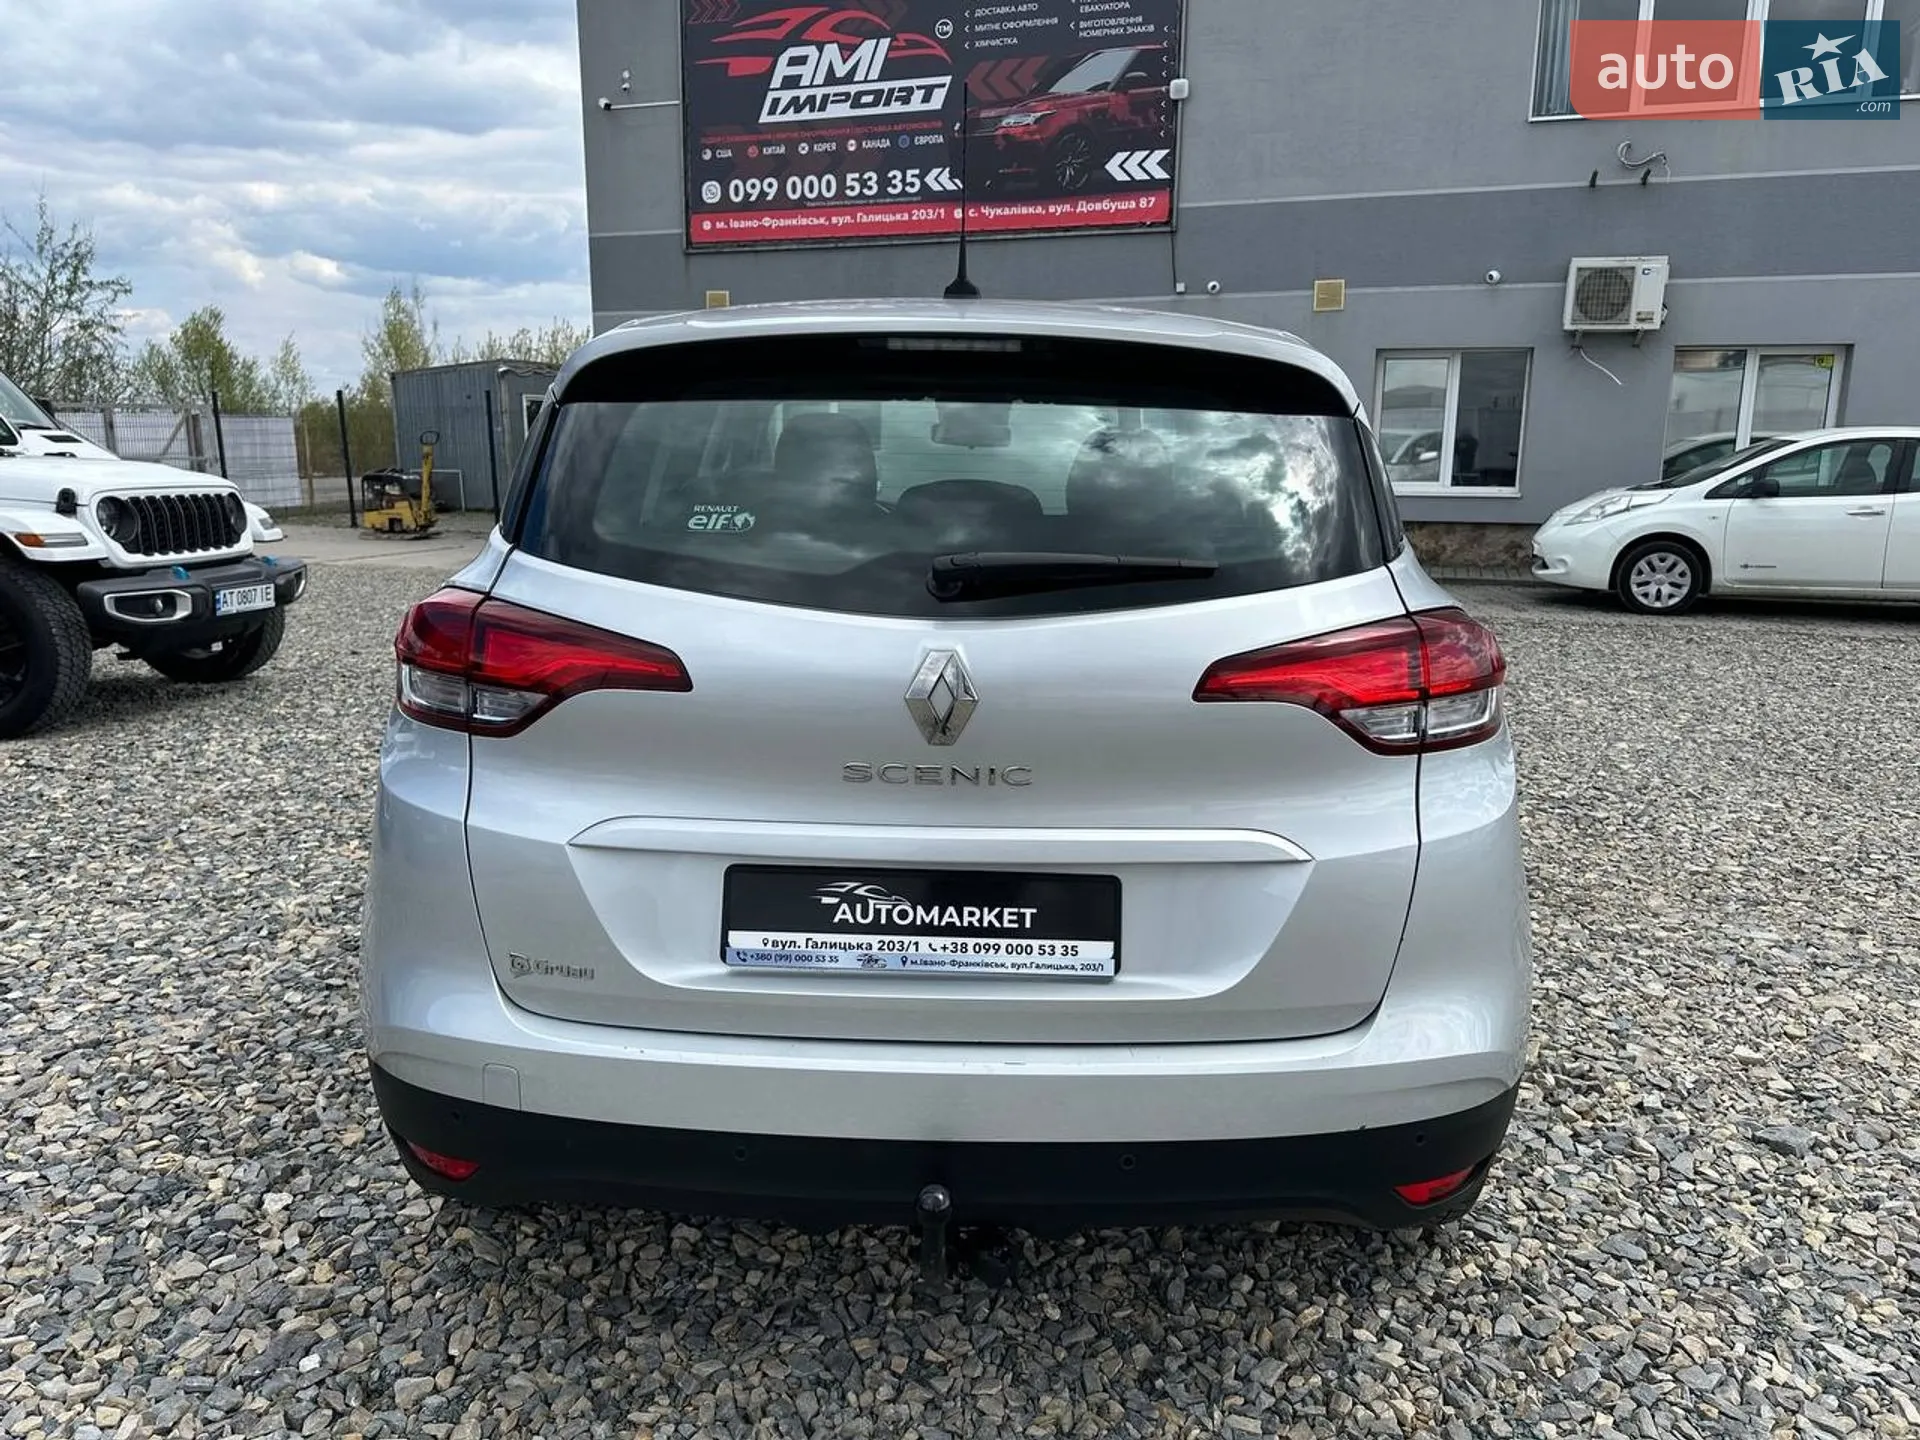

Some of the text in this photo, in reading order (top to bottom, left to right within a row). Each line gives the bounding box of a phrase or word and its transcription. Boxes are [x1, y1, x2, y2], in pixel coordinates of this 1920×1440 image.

[974, 3, 1038, 17] ДОСТАВКА АВТО
[1080, 2, 1130, 13] ЕВАКУАТОРА
[1002, 17, 1059, 29] ОФОРМЛЕННЯ
[1079, 16, 1143, 28] ВИГОТОВЛЕННЯ
[1079, 24, 1155, 38] НОМЕРНИХ ЗНАКІВ
[769, 37, 891, 89] AMI
[767, 82, 947, 116] IMPORT
[813, 142, 837, 152] КОРЕЯ
[862, 138, 891, 149] КАНАДА
[914, 134, 944, 146] ЄВРОПА
[716, 149, 732, 159] США
[763, 144, 786, 155] КИТАЙ
[728, 168, 921, 203] 099 000 53 35
[968, 196, 1156, 219] с. Чукалівка, вул. Довбуша 87
[715, 207, 945, 230] м. Івано-Франківськ, вул. Галицька 203/1
[693, 504, 739, 513] RENAULT
[237, 588, 257, 604] 0807
[842, 761, 1033, 786] SCENIC
[832, 902, 1038, 930] AUTOMARKET
[771, 937, 920, 953] вул. Галицька 203/1
[940, 941, 1080, 958] +38 099 000 53 35
[749, 952, 840, 964] +380 (99) 000 53 35
[1080, 962, 1104, 972] 203/1
